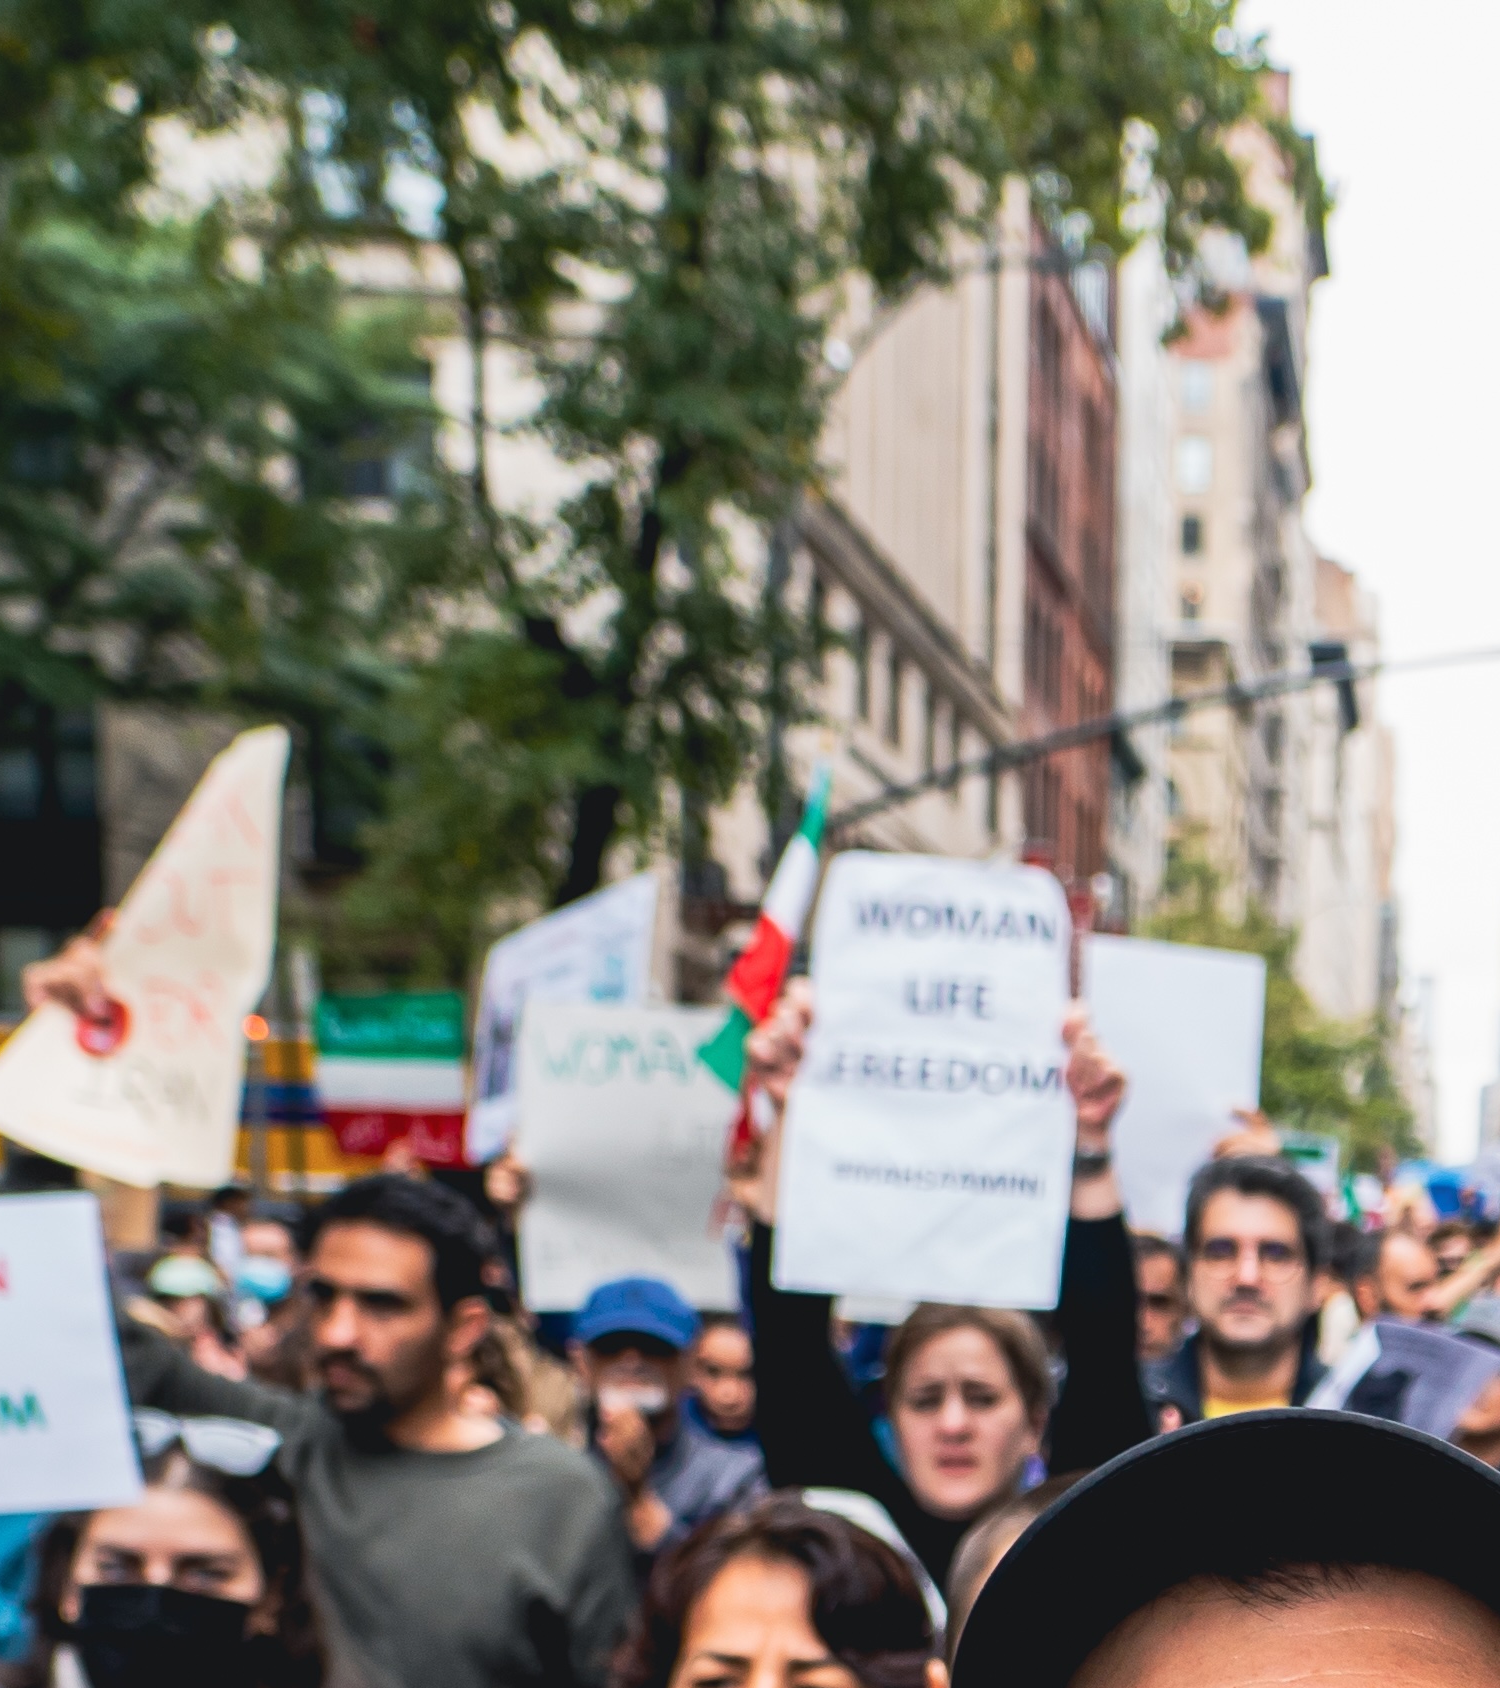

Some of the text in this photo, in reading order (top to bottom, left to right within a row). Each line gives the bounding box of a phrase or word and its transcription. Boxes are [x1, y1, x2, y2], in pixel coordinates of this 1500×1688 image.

[857, 901, 1057, 942] WOMAN
[905, 979, 995, 1021] LIFE
[532, 1026, 690, 1086] WOMA
[828, 1049, 1066, 1097] FREEDOM
